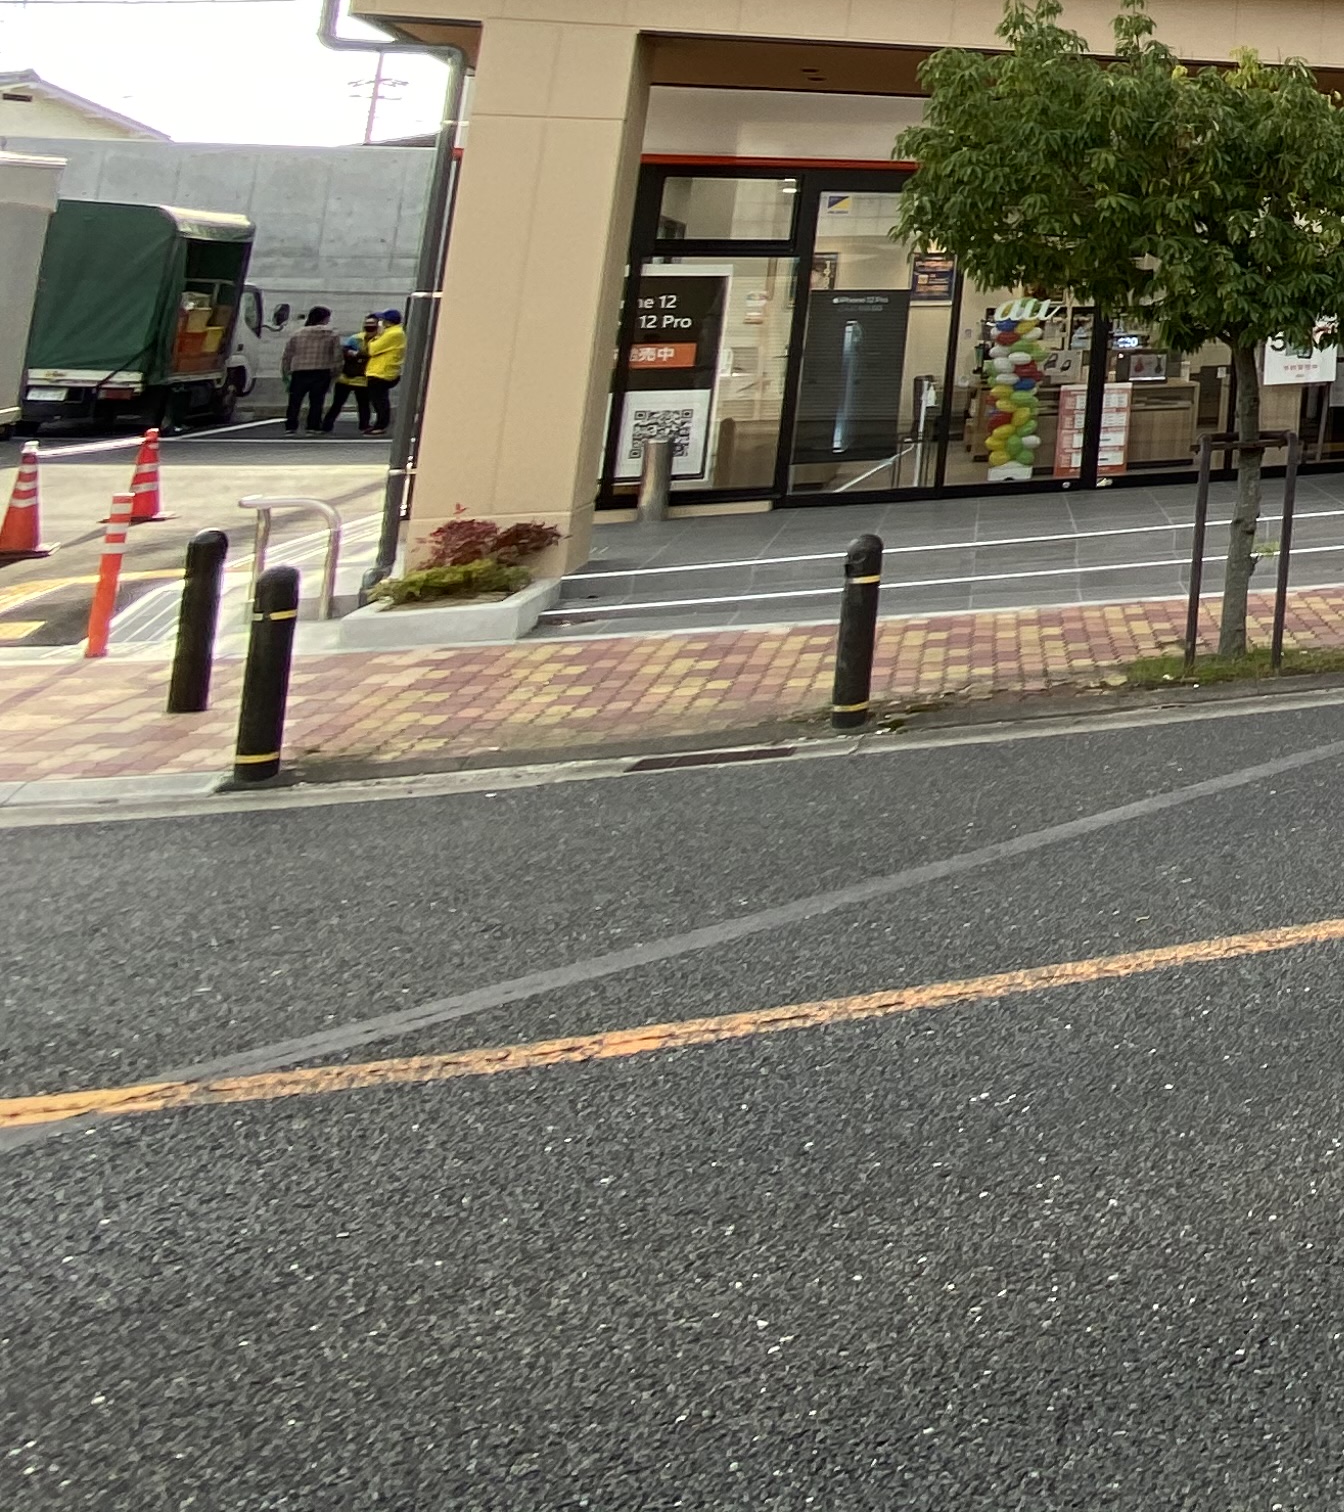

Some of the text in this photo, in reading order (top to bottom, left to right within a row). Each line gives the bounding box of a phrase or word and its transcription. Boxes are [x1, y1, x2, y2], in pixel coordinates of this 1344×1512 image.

[658, 294, 678, 309] 12
[639, 315, 692, 329] 12 Pro
